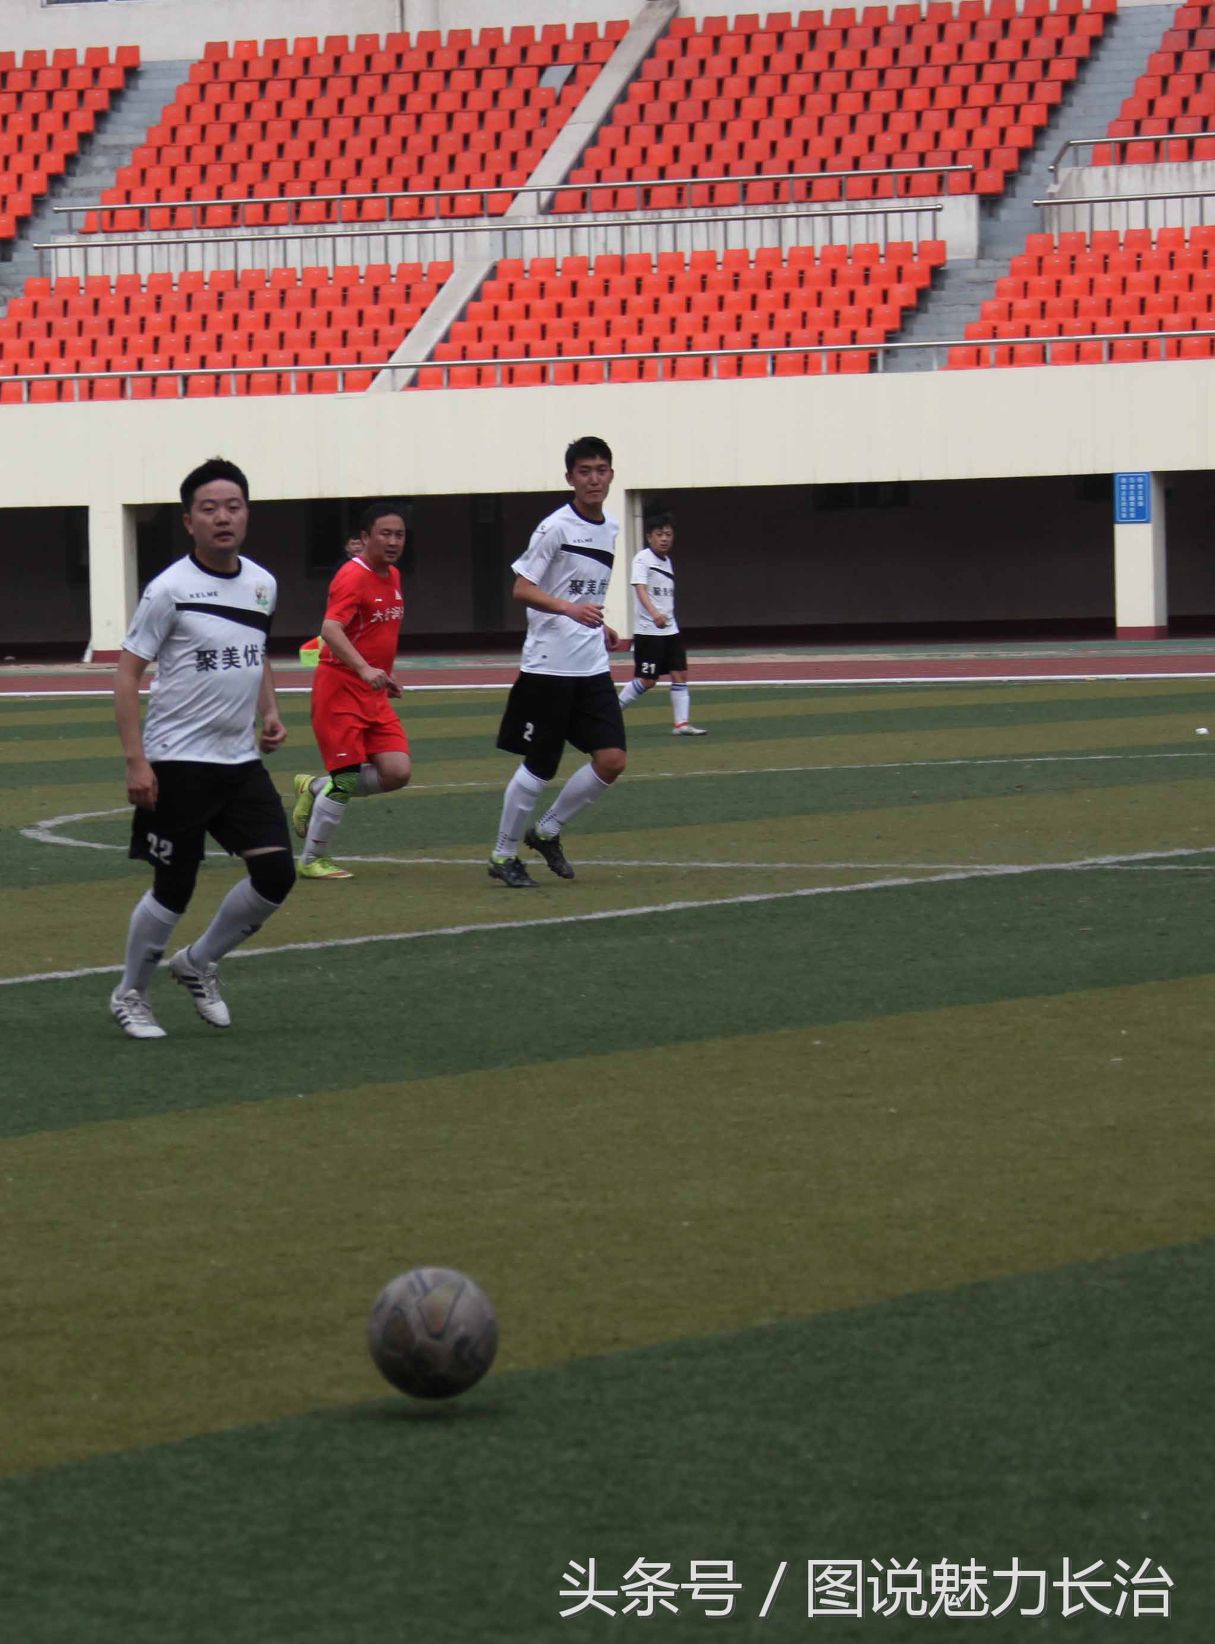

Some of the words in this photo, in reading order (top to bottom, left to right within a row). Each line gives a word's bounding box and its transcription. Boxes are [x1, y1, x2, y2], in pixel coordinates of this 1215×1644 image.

[189, 591, 218, 599] KELME
[641, 662, 656, 675] 21
[523, 721, 534, 742] 2
[147, 832, 173, 866] 22
